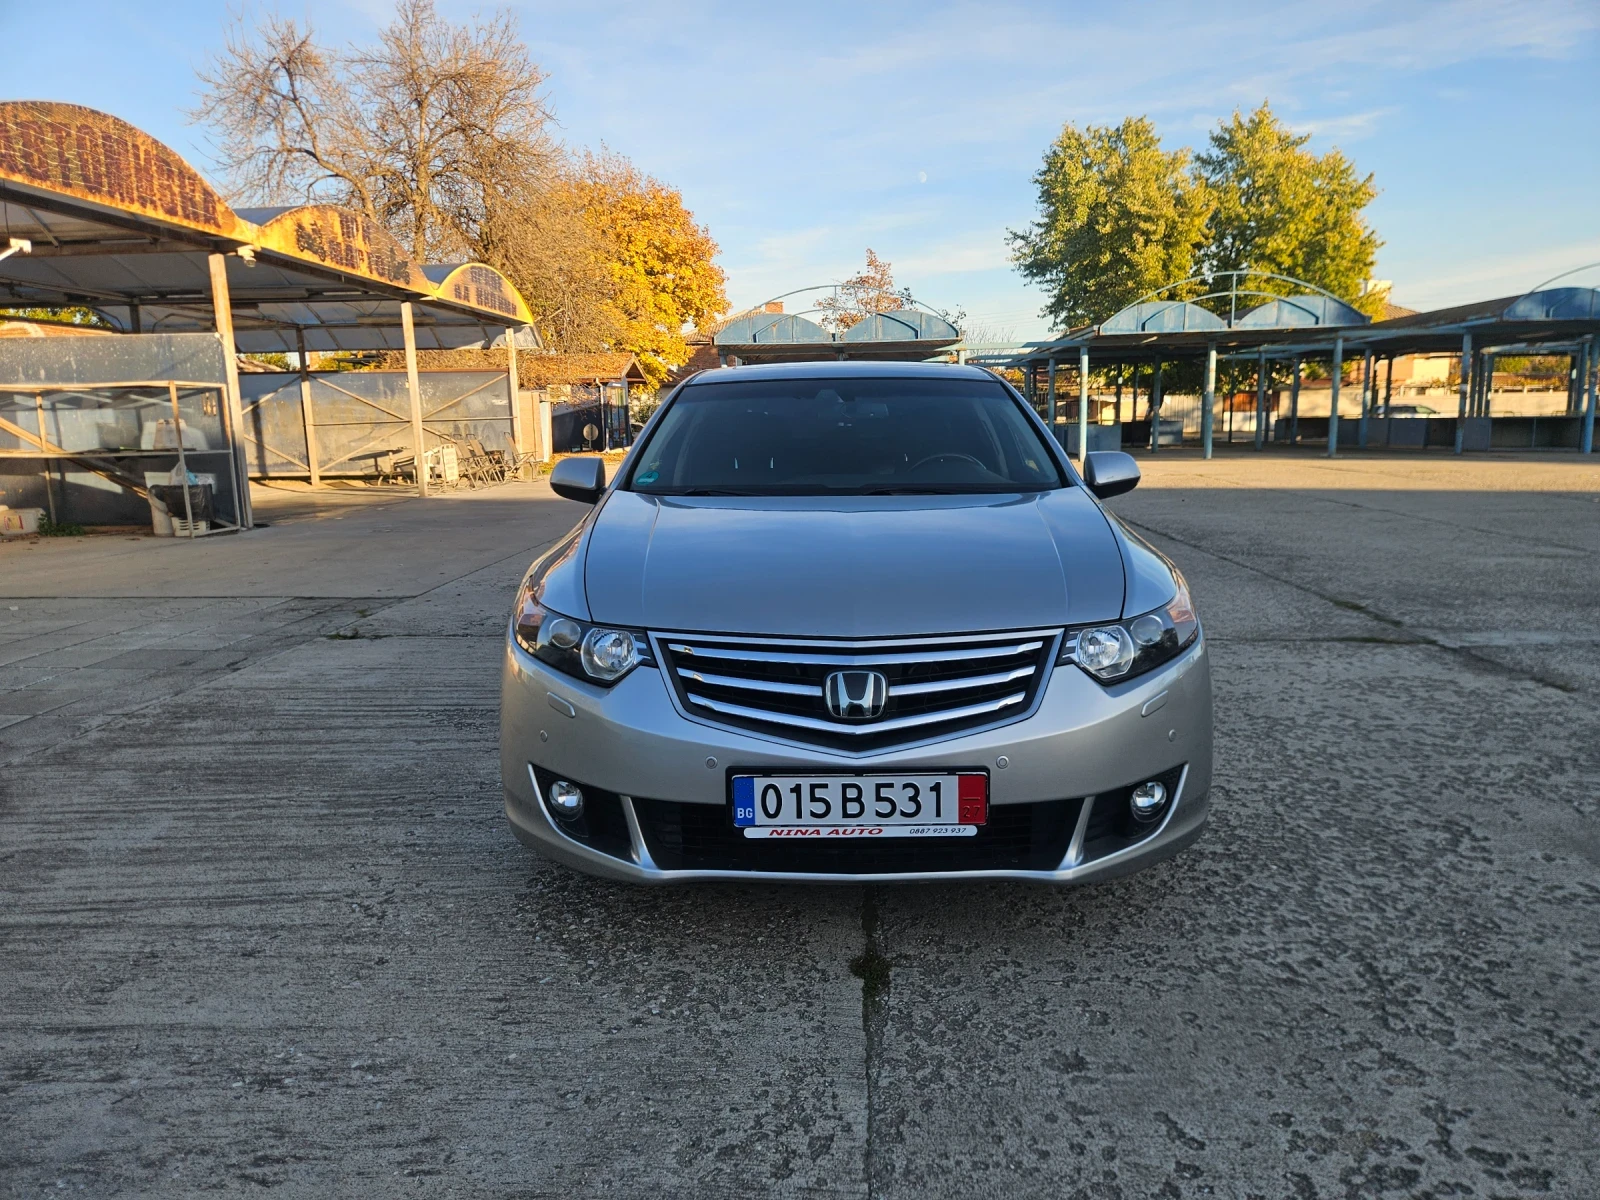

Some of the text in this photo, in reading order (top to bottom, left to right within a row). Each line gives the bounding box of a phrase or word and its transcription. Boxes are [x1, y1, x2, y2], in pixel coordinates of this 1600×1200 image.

[737, 807, 754, 819] BG
[963, 805, 981, 818] 27
[769, 828, 884, 837] NINA AUTO
